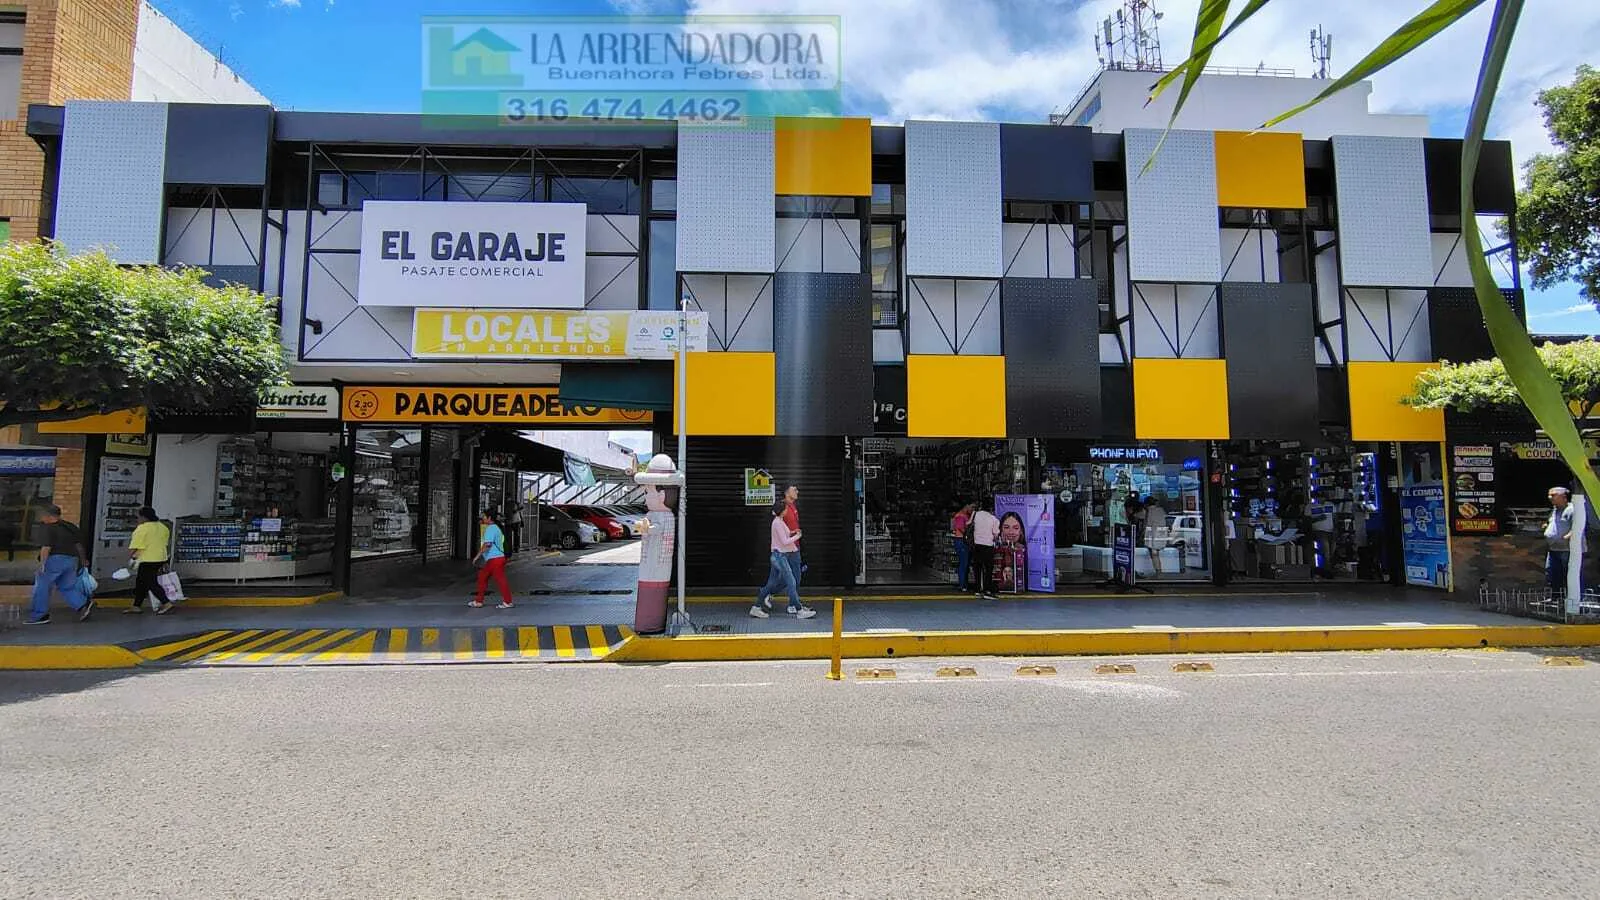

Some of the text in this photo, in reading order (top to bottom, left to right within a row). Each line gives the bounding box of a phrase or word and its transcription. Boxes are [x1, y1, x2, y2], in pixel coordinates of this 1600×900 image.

[381, 231, 566, 262] EL GARAJE
[402, 266, 544, 277] PASAJE COMERCIAL
[442, 314, 611, 342] LOCALES
[488, 344, 611, 353] ARRIENDO
[258, 390, 328, 408] aturista
